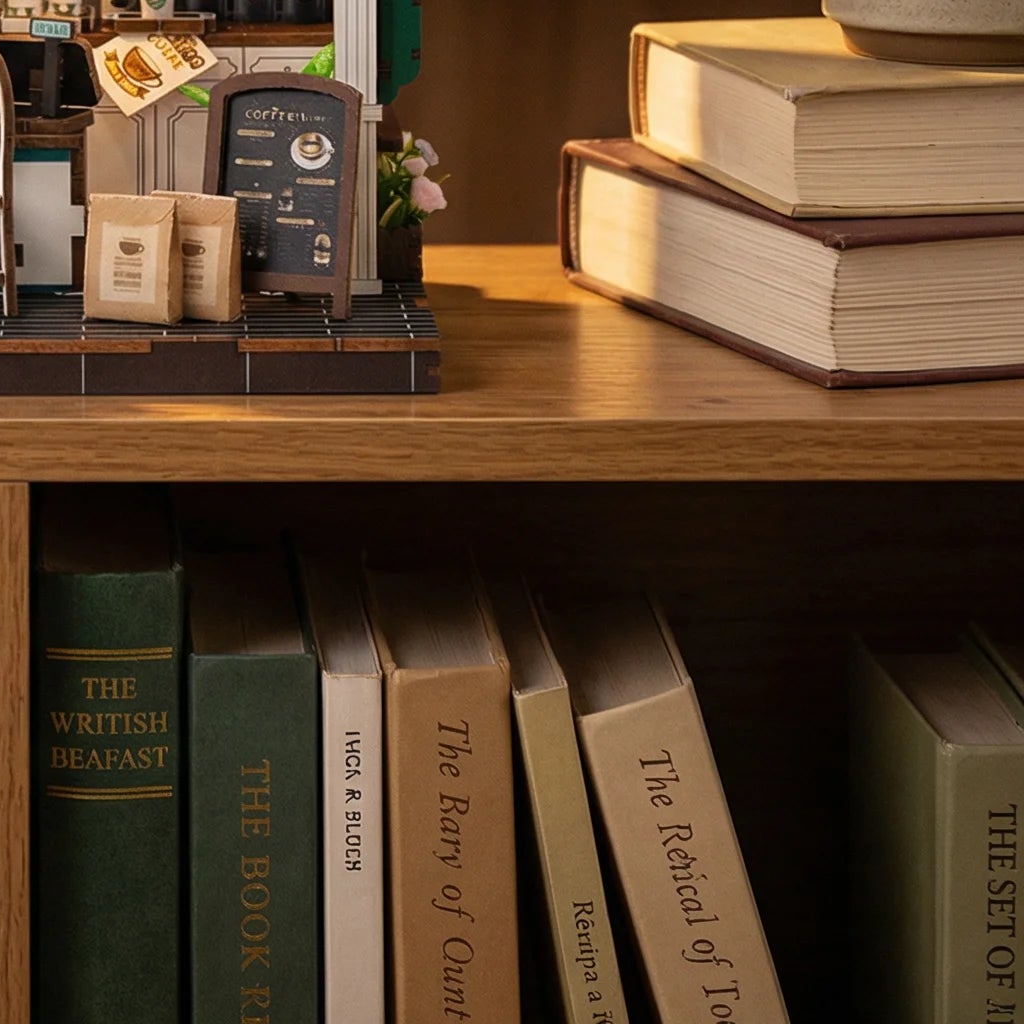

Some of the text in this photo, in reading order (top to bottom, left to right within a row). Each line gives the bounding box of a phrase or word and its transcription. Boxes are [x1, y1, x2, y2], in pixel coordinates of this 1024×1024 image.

[81, 677, 137, 700] THE
[50, 711, 169, 735] WRITISH
[438, 719, 473, 778] The
[50, 744, 169, 771] BEAFAST
[240, 759, 271, 838] THE
[639, 749, 680, 808] The
[682, 938, 733, 969] of
[988, 803, 1018, 871] THE
[240, 855, 271, 972] BOOK
[431, 884, 475, 923] of
[987, 879, 1017, 938] SET
[986, 945, 1016, 989] OF
